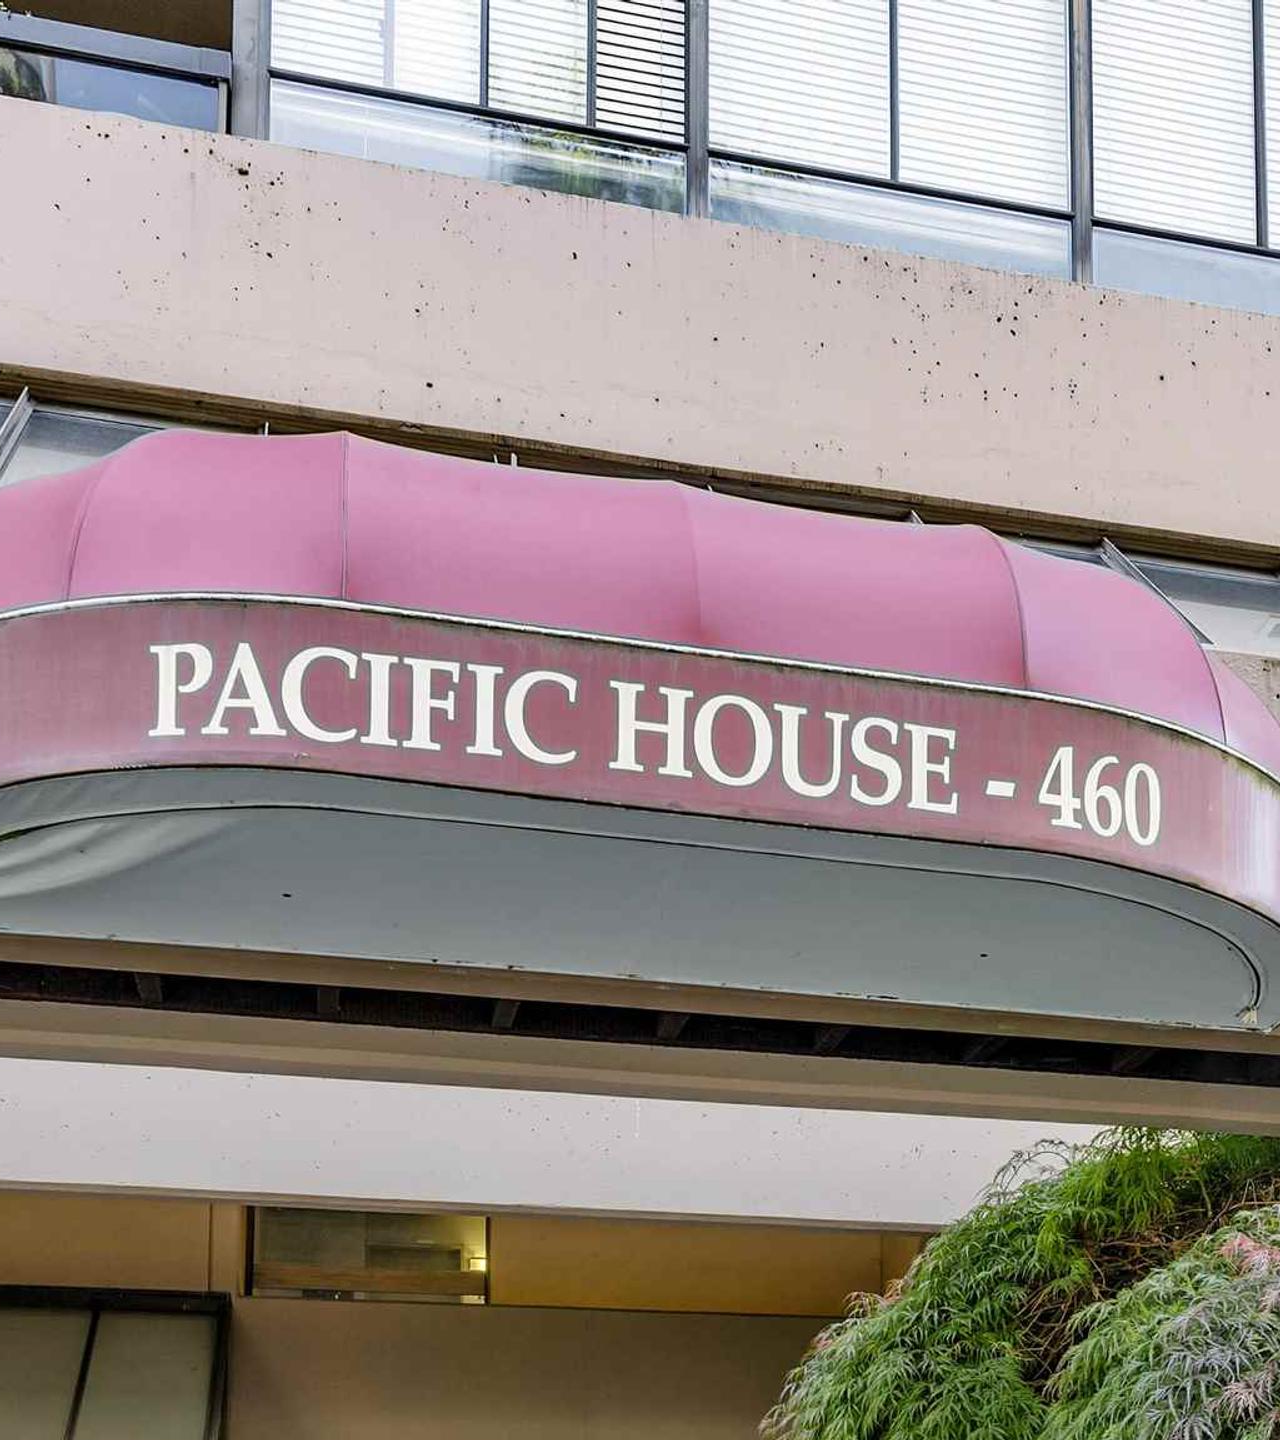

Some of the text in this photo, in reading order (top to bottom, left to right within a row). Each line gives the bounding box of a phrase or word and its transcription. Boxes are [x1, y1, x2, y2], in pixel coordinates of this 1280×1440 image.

[149, 642, 1161, 846] PACIFIC HOUSE - 460
